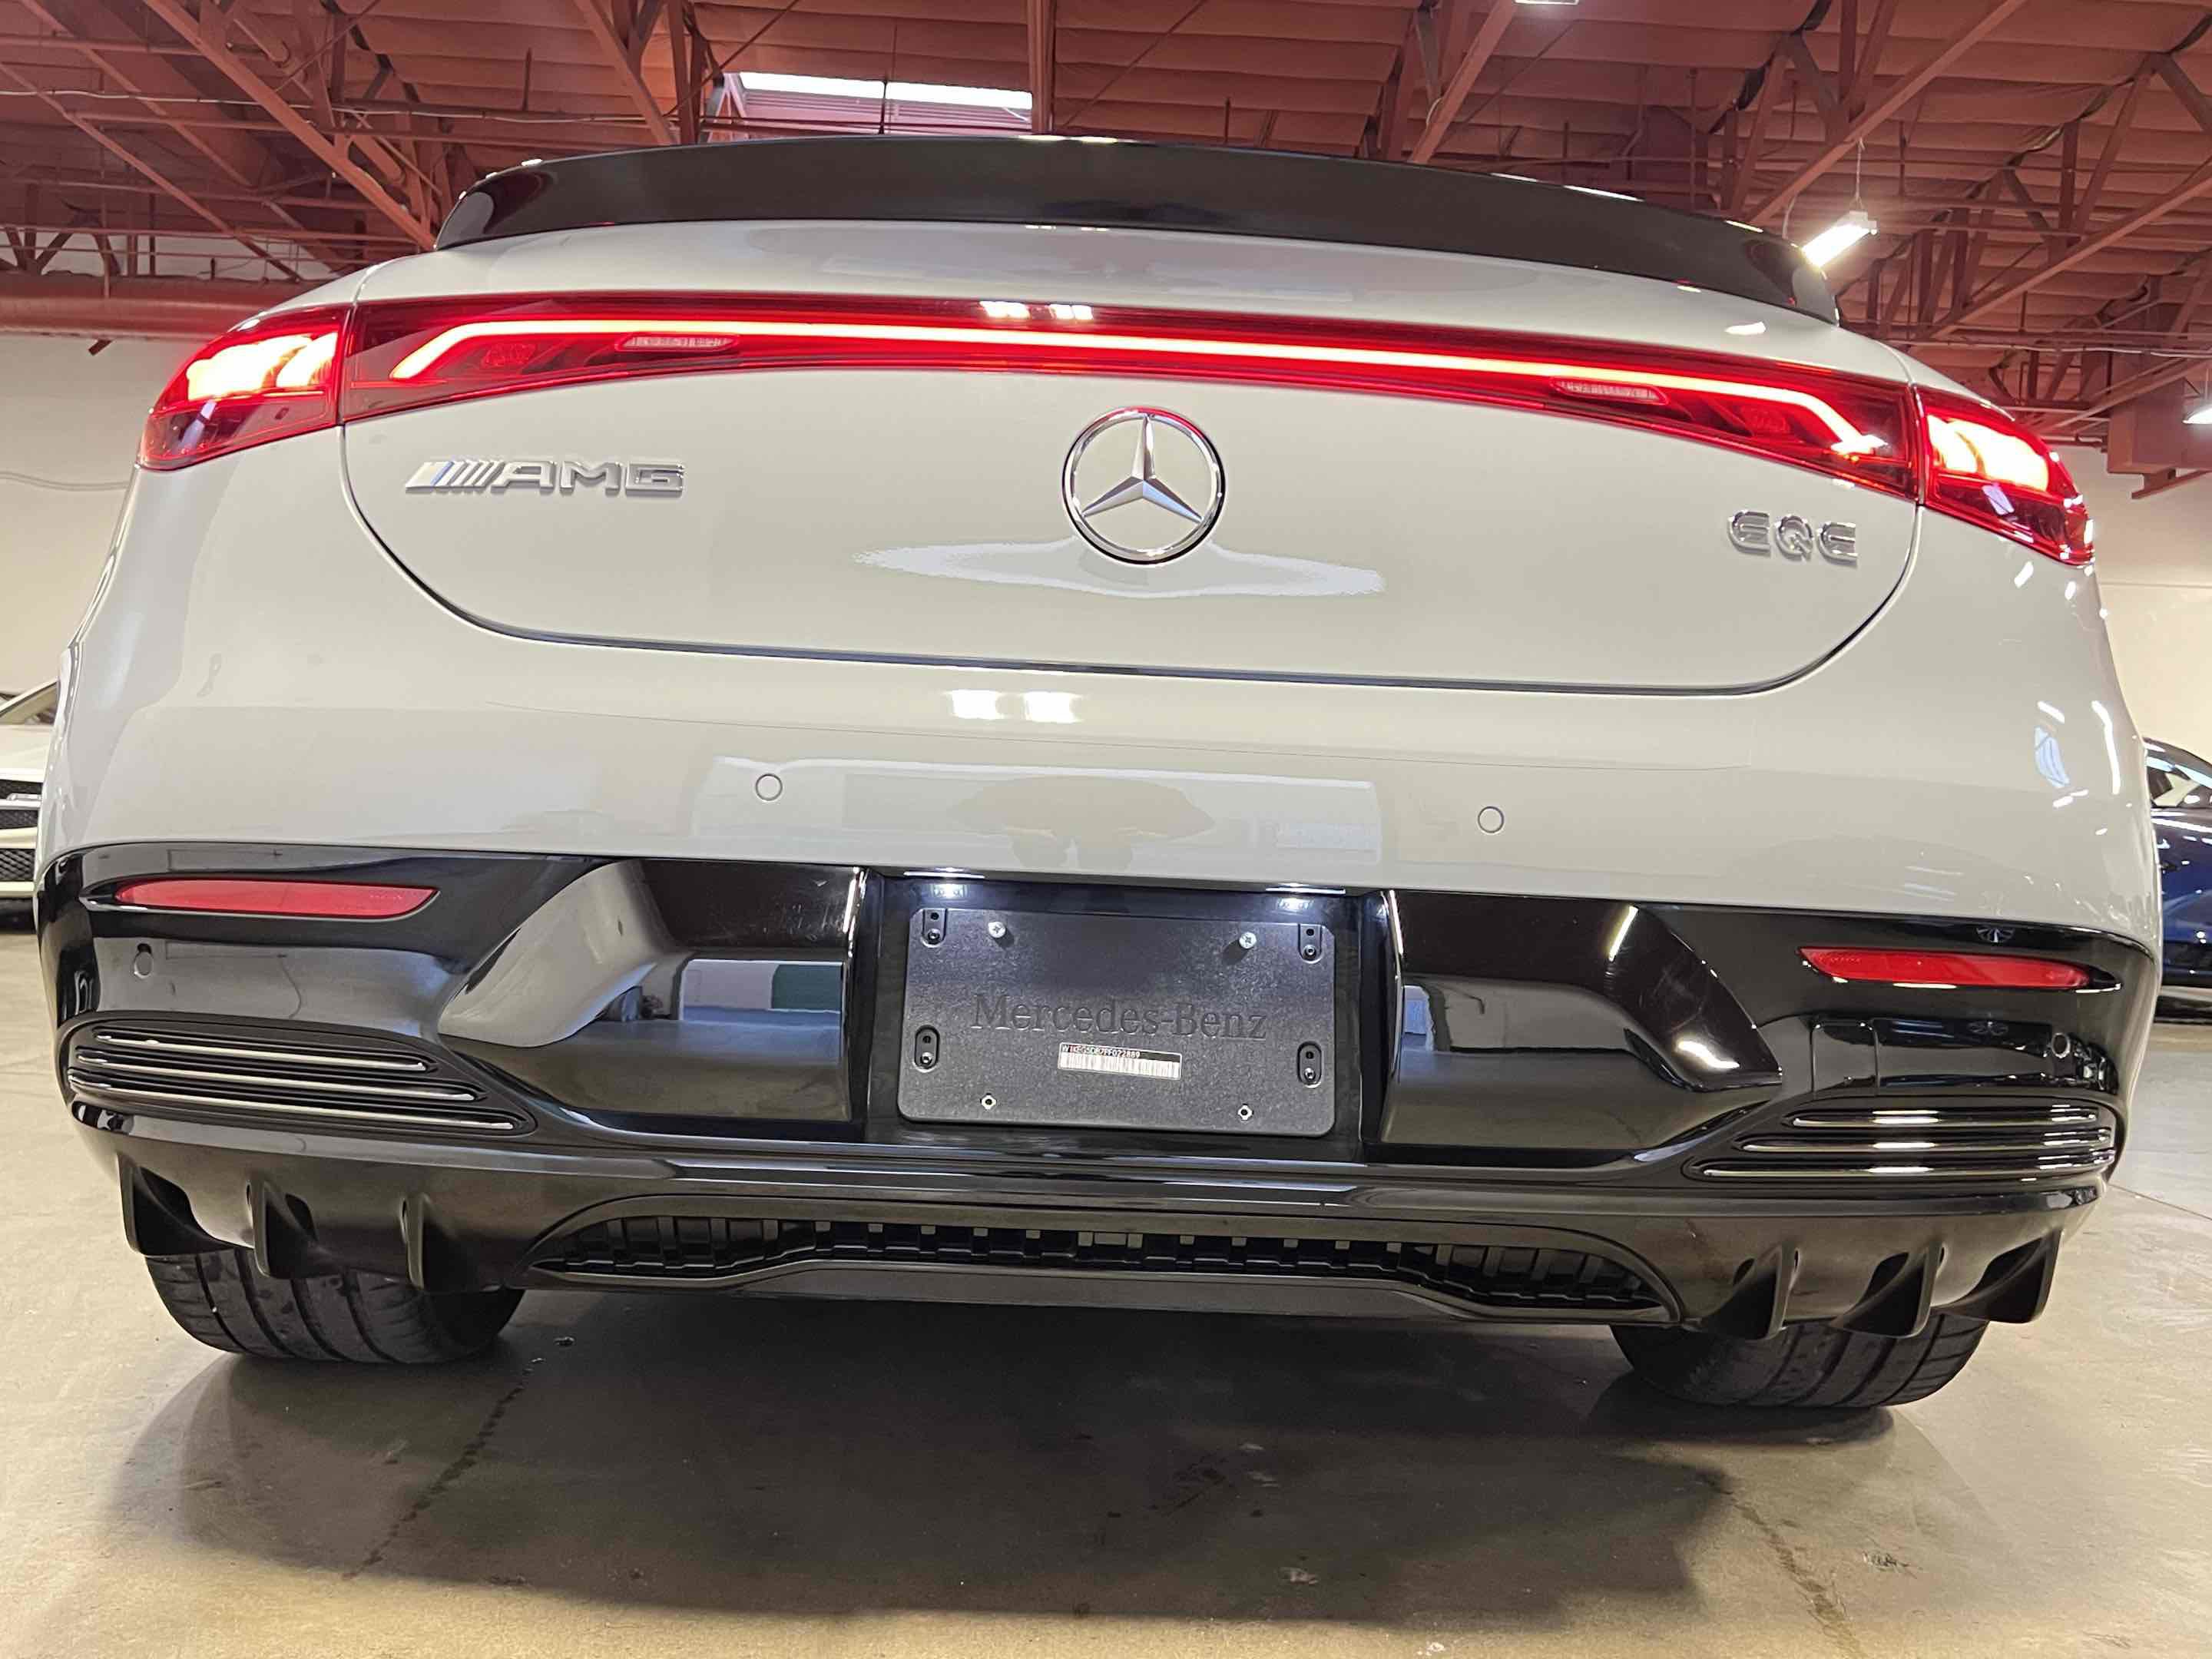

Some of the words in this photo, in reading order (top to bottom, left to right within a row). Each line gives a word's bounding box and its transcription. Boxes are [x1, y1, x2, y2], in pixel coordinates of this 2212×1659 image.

[490, 460, 686, 498] AMG
[1728, 510, 1858, 568] EQE
[970, 993, 1267, 1041] Mercedes-Benz
